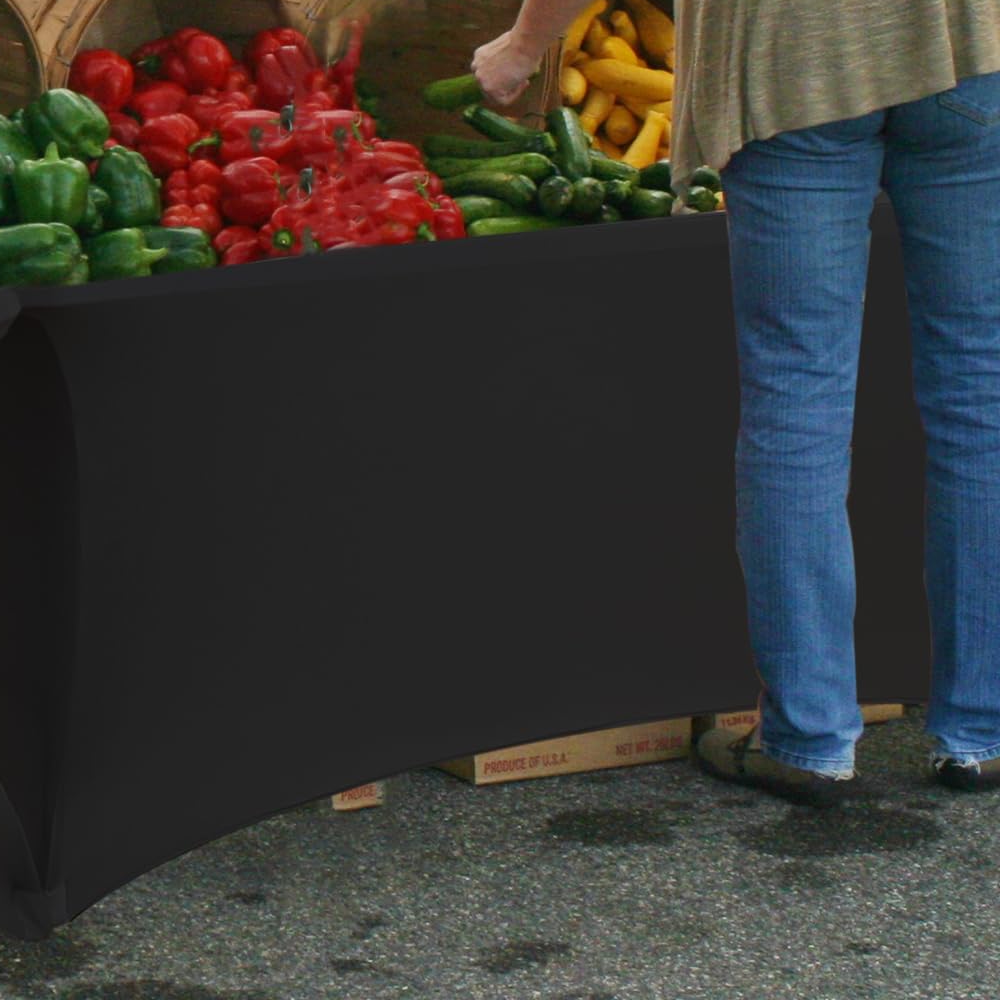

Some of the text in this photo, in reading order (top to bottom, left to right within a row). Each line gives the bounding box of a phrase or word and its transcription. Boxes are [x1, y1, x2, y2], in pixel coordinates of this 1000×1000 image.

[615, 743, 633, 757] NET
[484, 757, 527, 775] PRODUCE
[528, 754, 541, 769] OF
